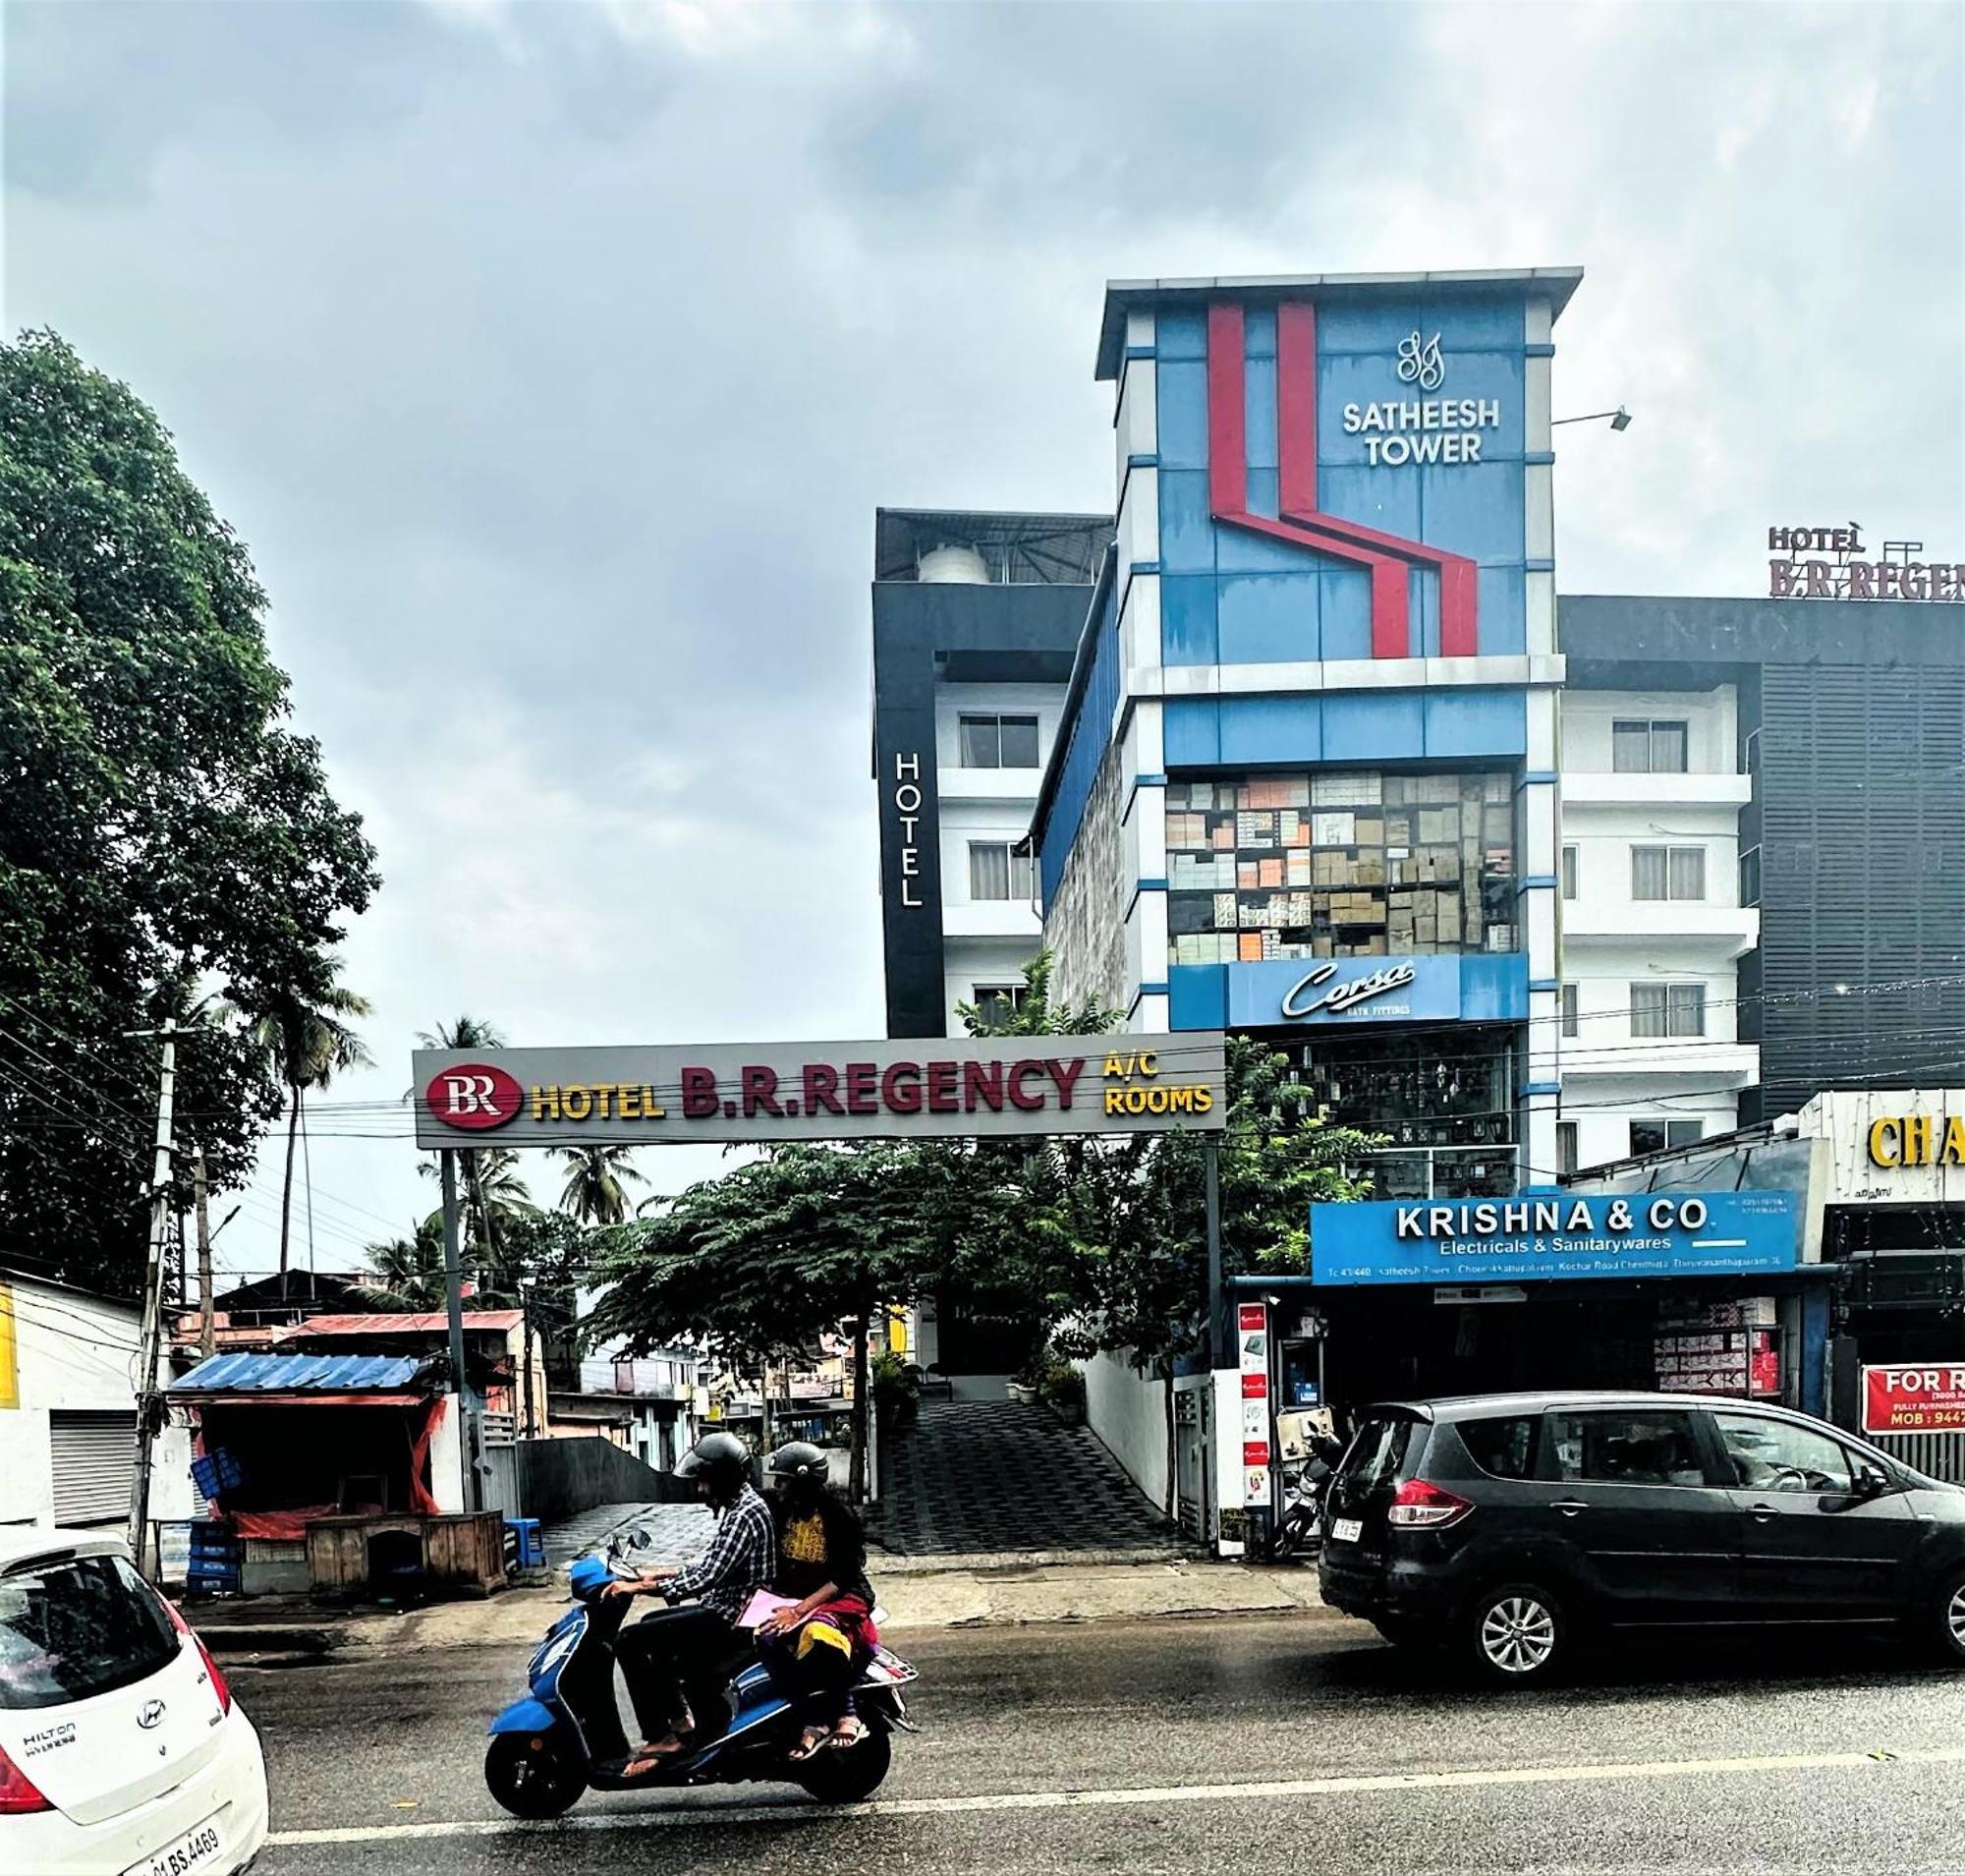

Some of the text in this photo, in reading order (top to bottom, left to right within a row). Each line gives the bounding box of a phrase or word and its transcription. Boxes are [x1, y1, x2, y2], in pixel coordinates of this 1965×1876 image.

[1343, 399, 1499, 434] SATHEESH
[1365, 433, 1482, 466] TOWER
[1768, 527, 1866, 552] HOTEL
[895, 753, 923, 906] HOTEL
[1281, 961, 1416, 1018] Corsa
[1103, 1049, 1160, 1084] A/C
[532, 1083, 666, 1121] HOTEL
[681, 1058, 1087, 1118] B.R.REGENCY
[1104, 1084, 1214, 1116] ROOMS
[1398, 1201, 1596, 1238] KRISHNA
[1607, 1199, 1634, 1229] &
[1440, 1237, 1671, 1255] Electricals & Sanitarywares
[1886, 1370, 1941, 1393] FOR
[1890, 1412, 1924, 1425] MOB
[24, 1722, 76, 1745] HILTON
